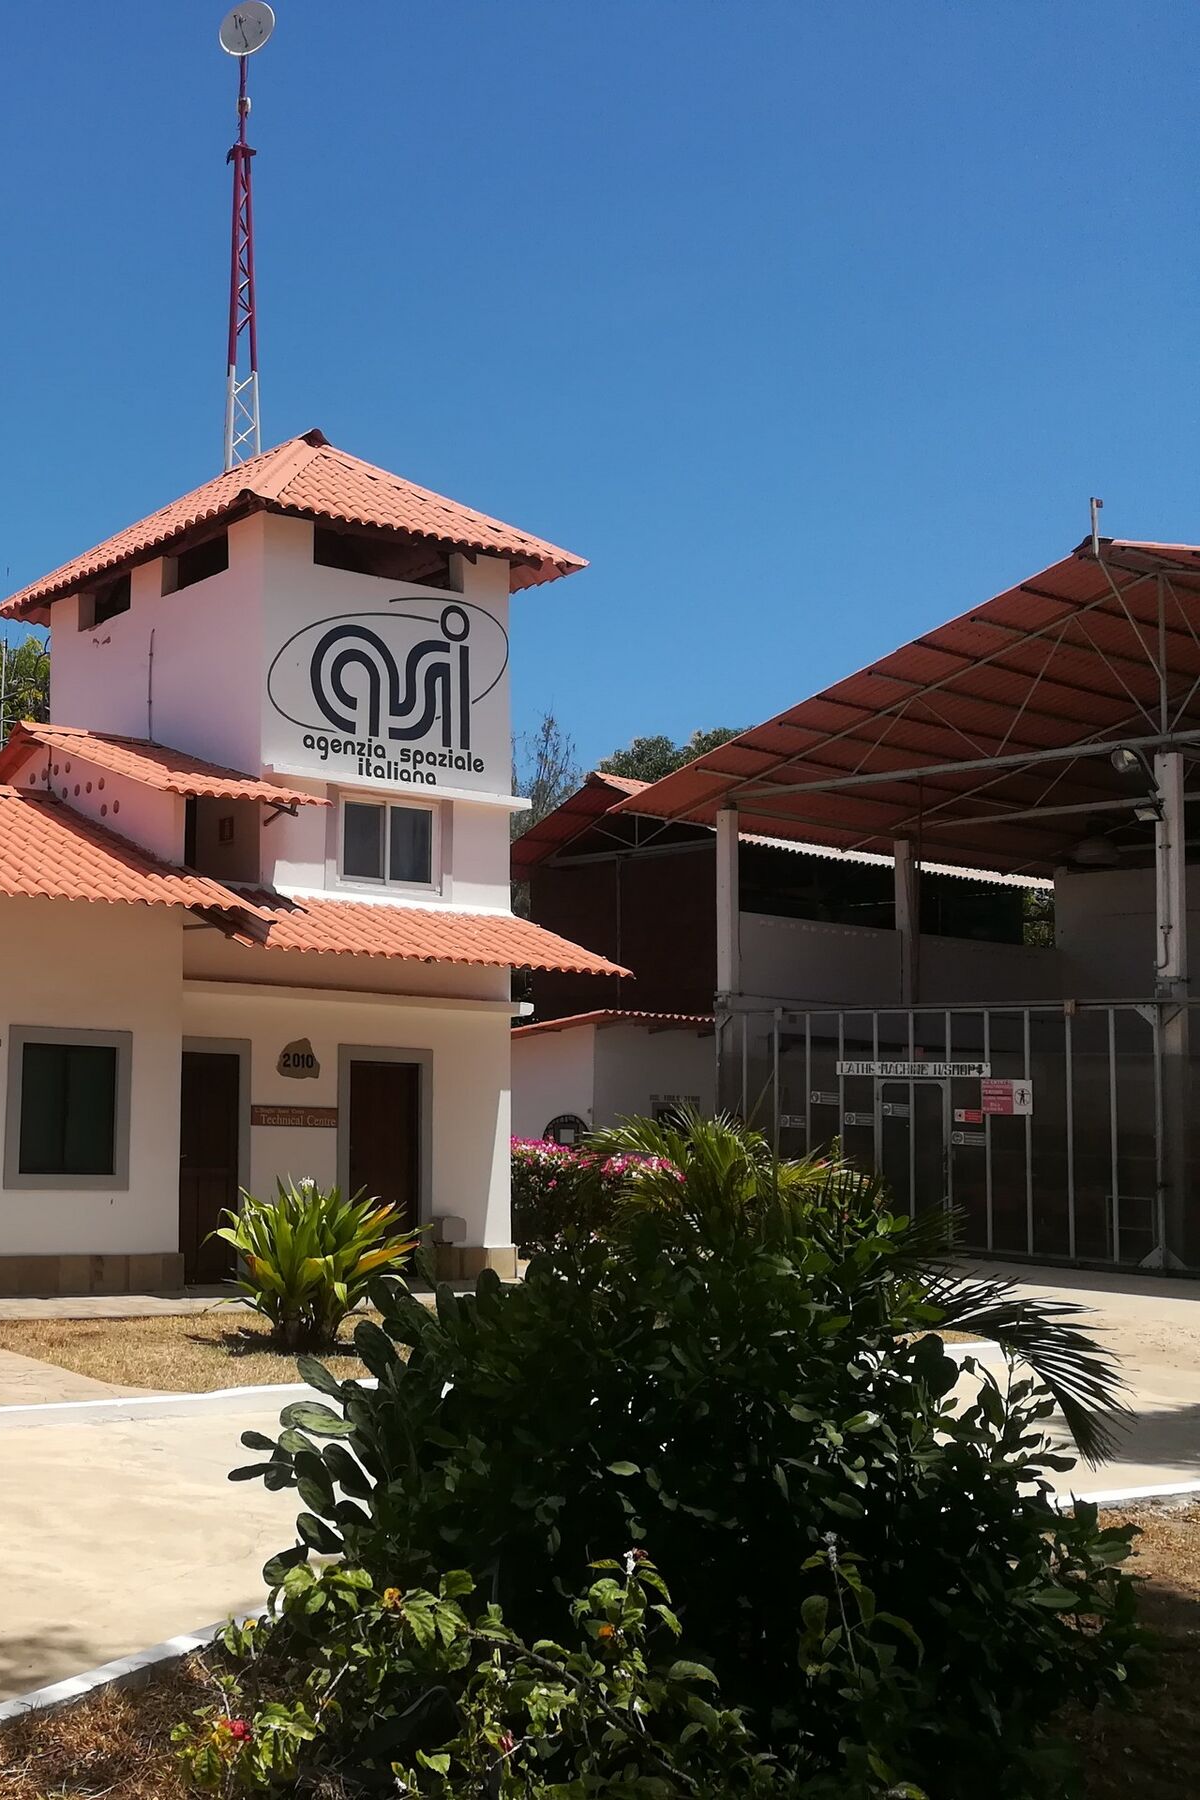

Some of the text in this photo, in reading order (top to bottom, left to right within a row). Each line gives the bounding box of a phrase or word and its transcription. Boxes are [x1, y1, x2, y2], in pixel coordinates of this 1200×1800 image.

[302, 733, 485, 773] agenzia spaziale
[358, 758, 437, 785] italiana
[282, 1052, 314, 1069] 2010
[260, 1113, 337, 1127] Technical Centre
